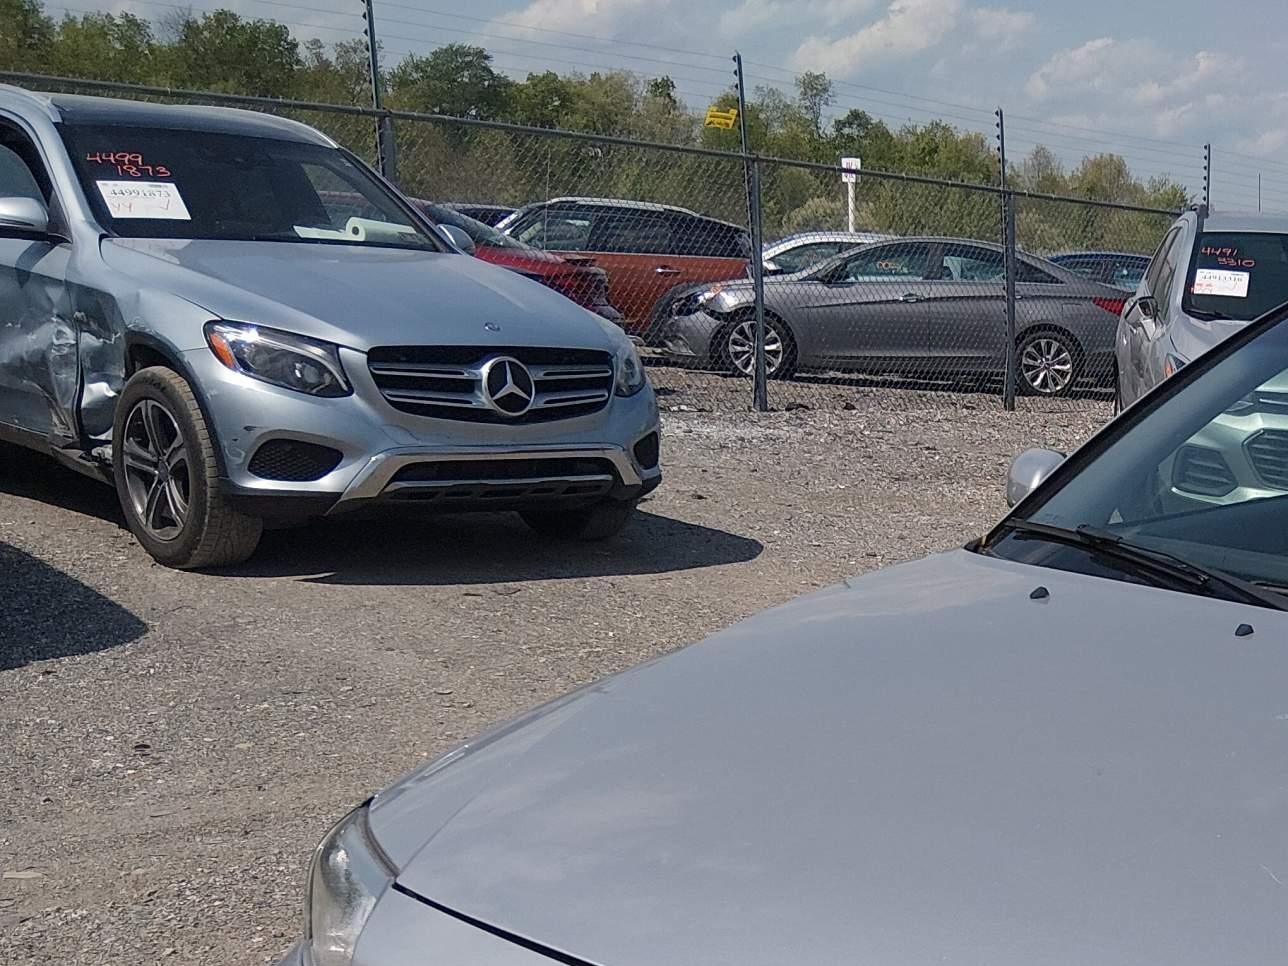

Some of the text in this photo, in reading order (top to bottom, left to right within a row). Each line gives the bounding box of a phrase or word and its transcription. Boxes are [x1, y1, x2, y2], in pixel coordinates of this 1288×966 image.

[86, 152, 143, 165] 4499
[117, 165, 171, 177] 1873
[1201, 246, 1238, 257] 4491
